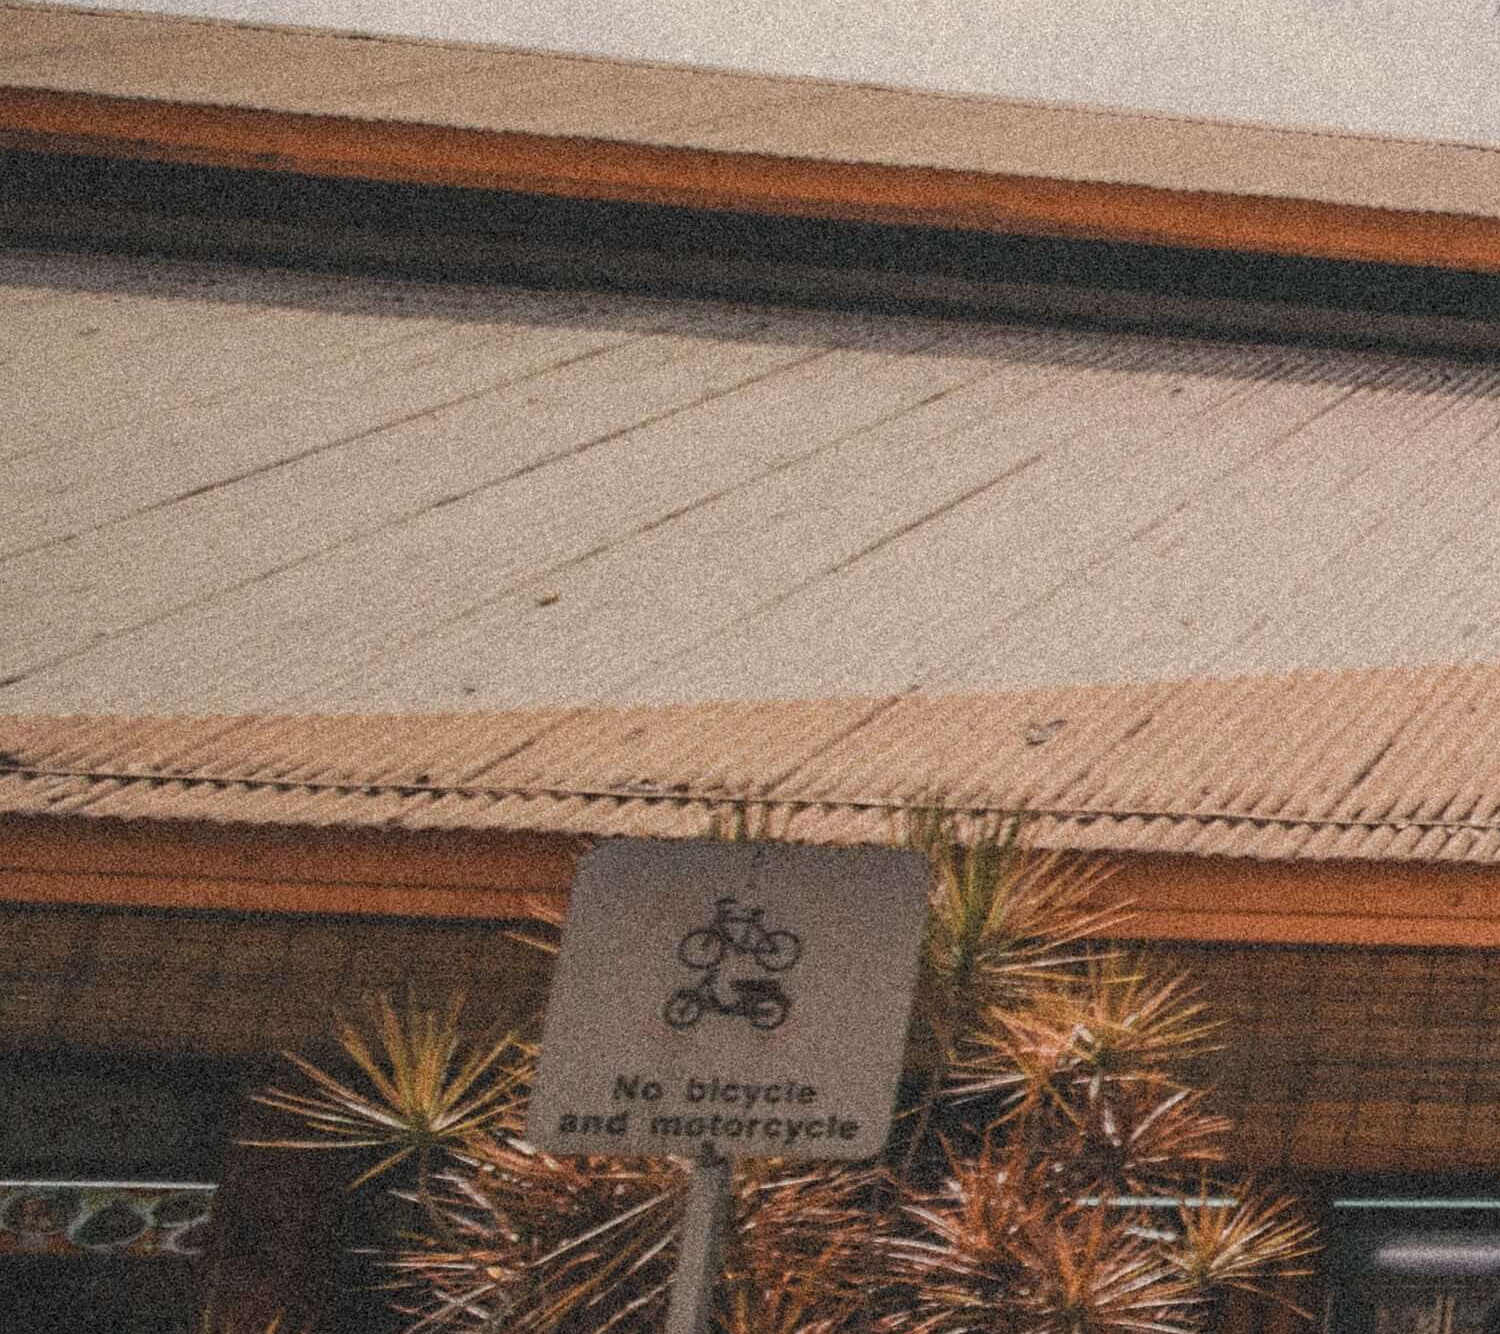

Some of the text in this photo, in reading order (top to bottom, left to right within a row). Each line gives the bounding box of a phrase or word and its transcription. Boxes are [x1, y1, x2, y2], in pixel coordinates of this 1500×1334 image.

[612, 1075, 817, 1109] No bicycle
[558, 1111, 860, 1144] and motorcycle
